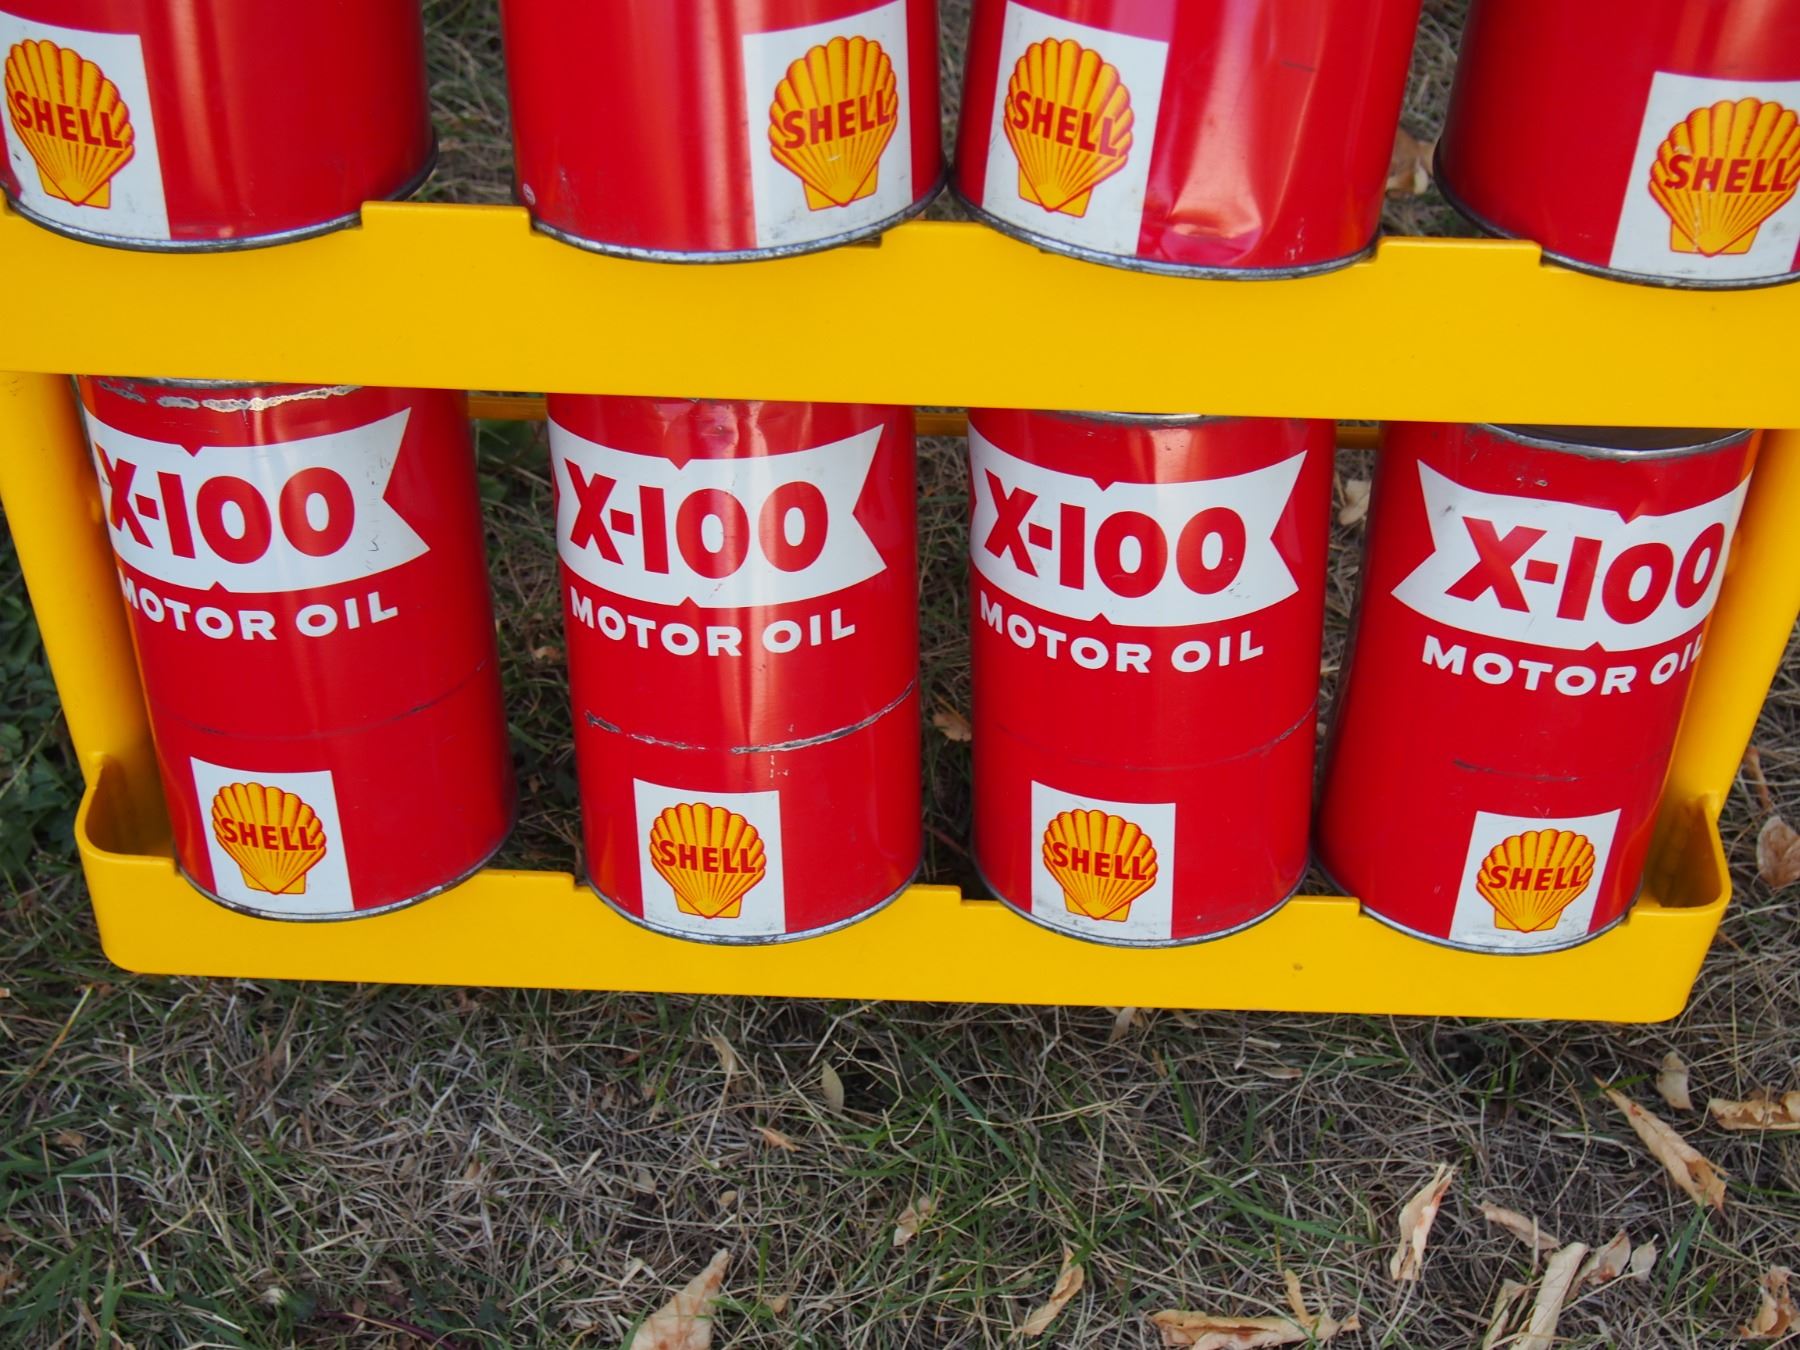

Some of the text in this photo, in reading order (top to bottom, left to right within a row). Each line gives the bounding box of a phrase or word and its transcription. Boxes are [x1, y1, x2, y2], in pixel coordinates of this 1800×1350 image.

[13, 90, 127, 149] SHELL
[781, 91, 893, 150] SHELL
[1012, 91, 1119, 157] SHELL
[1663, 154, 1789, 193] SHELL
[95, 442, 355, 564] X-100
[564, 457, 829, 579] X-100
[985, 468, 1247, 599] X-100
[1444, 515, 1725, 624] X-100
[296, 591, 399, 638] OIL
[570, 585, 856, 656] MOTOR OIL
[980, 590, 1264, 674] MOTOR OIL
[1421, 635, 1637, 696] MOTOR
[214, 817, 317, 853] SHELL
[658, 839, 757, 875] SHELL
[1051, 841, 1148, 882] SHELL
[1488, 862, 1583, 892] SHELL
